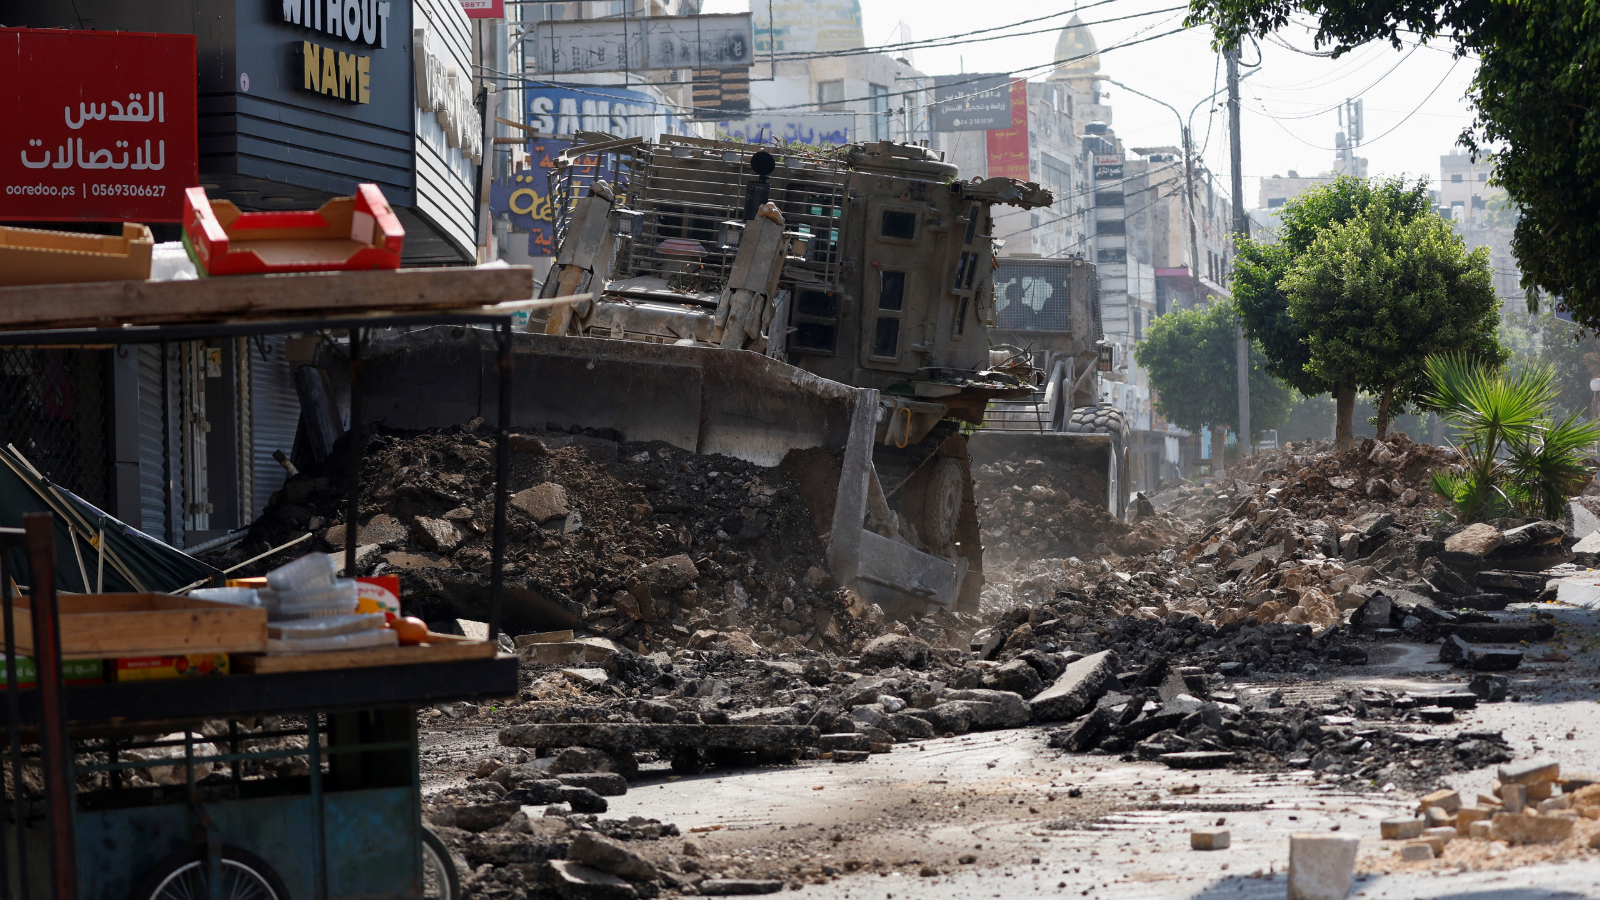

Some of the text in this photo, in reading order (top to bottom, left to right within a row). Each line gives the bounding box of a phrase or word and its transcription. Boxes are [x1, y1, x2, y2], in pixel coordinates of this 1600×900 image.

[303, 40, 370, 105] NAME
[64, 91, 165, 130] القدس
[20, 137, 166, 171] للاتصالات
[6, 182, 76, 199] ooredoo.ps
[92, 183, 166, 197] 0569306627
